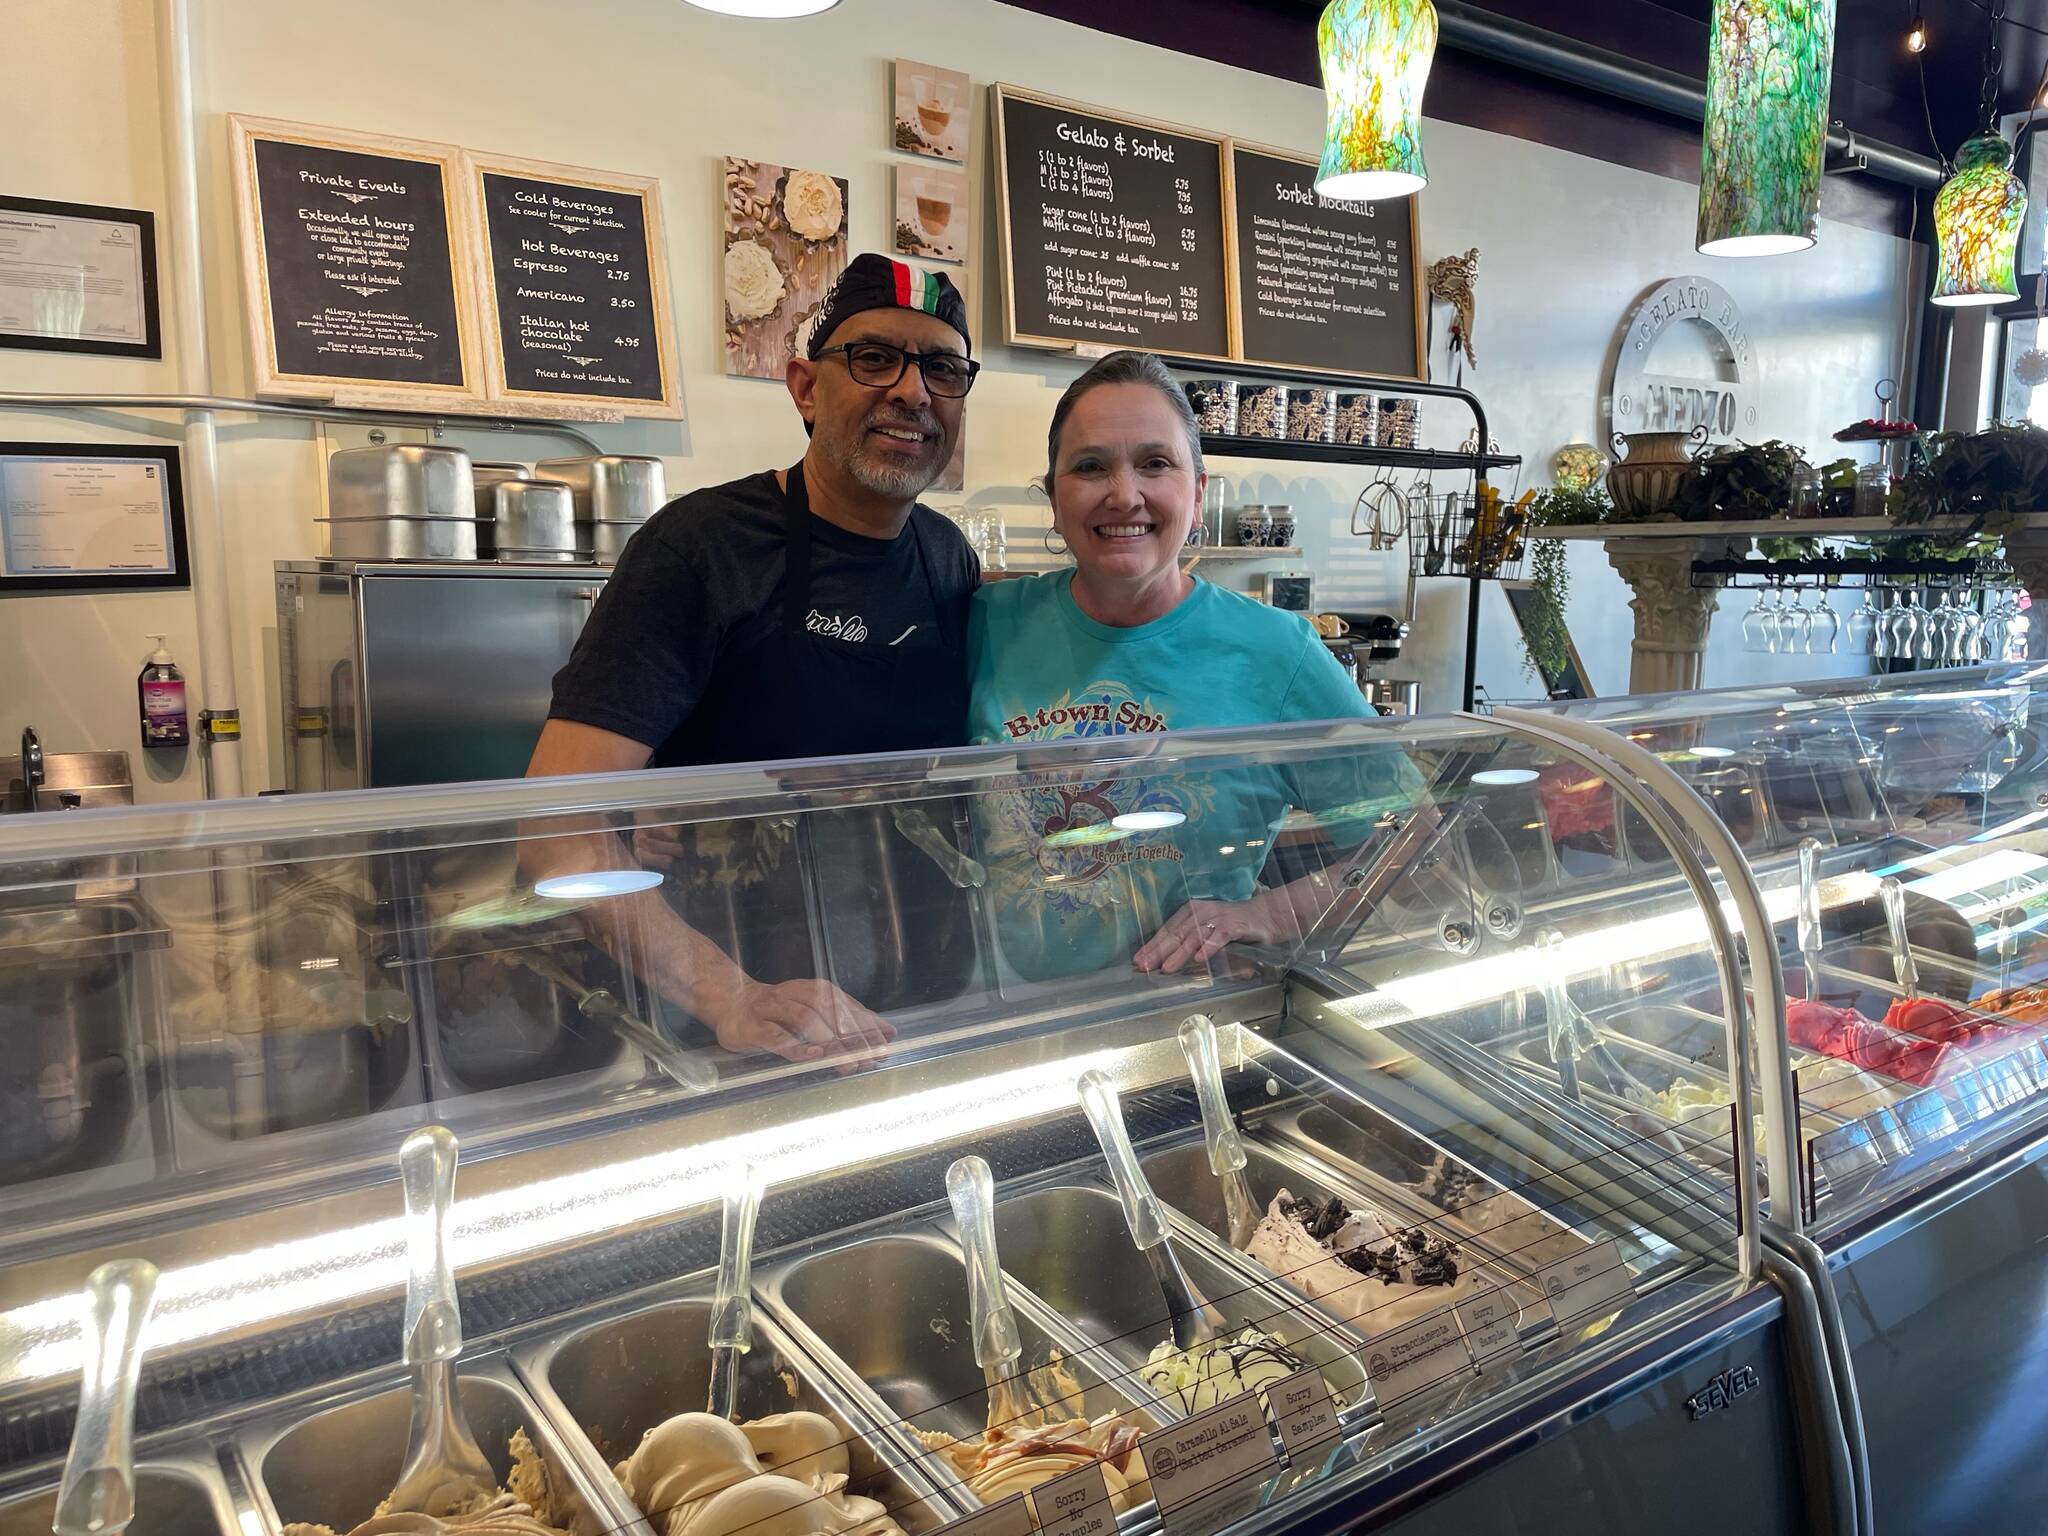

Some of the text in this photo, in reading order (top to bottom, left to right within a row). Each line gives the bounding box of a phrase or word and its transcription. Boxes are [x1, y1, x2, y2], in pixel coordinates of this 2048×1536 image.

[1056, 122, 1175, 164] Gelato & Sorbet
[1039, 150, 1190, 190] S (1 to 2 flavors) 5.75
[299, 170, 407, 194] Private Events
[1040, 164, 1191, 202] M (1 to 3 flavors) 7.95
[514, 192, 614, 216] Cold Beverages
[1040, 176, 1194, 214] L (1 to 4 flavors) 9.50
[1276, 183, 1314, 206] Sorbet
[299, 209, 415, 232] Extended hours
[508, 206, 626, 229] See cooler for current selection.
[1042, 203, 1196, 240] Sugar cone (1 to 2 flavors) 5.75
[355, 237, 362, 245] to
[1043, 216, 1196, 252] Waffle cone (1 to 3 flavors) 9.75
[522, 240, 619, 264] Hot Beverages
[1044, 242, 1058, 251] add
[1116, 252, 1130, 262] add
[324, 270, 346, 280] Please
[360, 272, 366, 284] if
[514, 258, 630, 280] Espresso 2.75
[1046, 266, 1198, 298] Pint (1 to 2 flavors) 16.75
[1046, 279, 1064, 292] Pint
[1066, 282, 1103, 296] Pistachio
[1106, 286, 1142, 304] (premium
[1145, 290, 1172, 308] flavor)
[516, 287, 636, 308] Americano 3.50
[1047, 292, 1084, 308] Affogato
[324, 308, 409, 322] Allergy information
[520, 316, 590, 332] Italian hot
[1048, 314, 1070, 326] Prices
[1072, 316, 1082, 326] do
[1084, 319, 1097, 328] not
[1099, 320, 1126, 332] include
[1640, 286, 1709, 342] GELATO
[521, 327, 640, 347] chocolate 4.95
[522, 338, 572, 352] (seasonal)
[535, 368, 558, 378] Prices
[561, 370, 570, 379] do
[588, 374, 616, 383] include
[1116, 701, 1167, 733] Spi
[1092, 844, 1184, 862] Recover Together
[1286, 1388, 1310, 1404] Sorry
[1688, 1366, 1760, 1419] SEVEL
[1292, 1414, 1327, 1436] Samples
[1176, 1428, 1218, 1454] Caramello
[1056, 1488, 1086, 1508] Sorry
